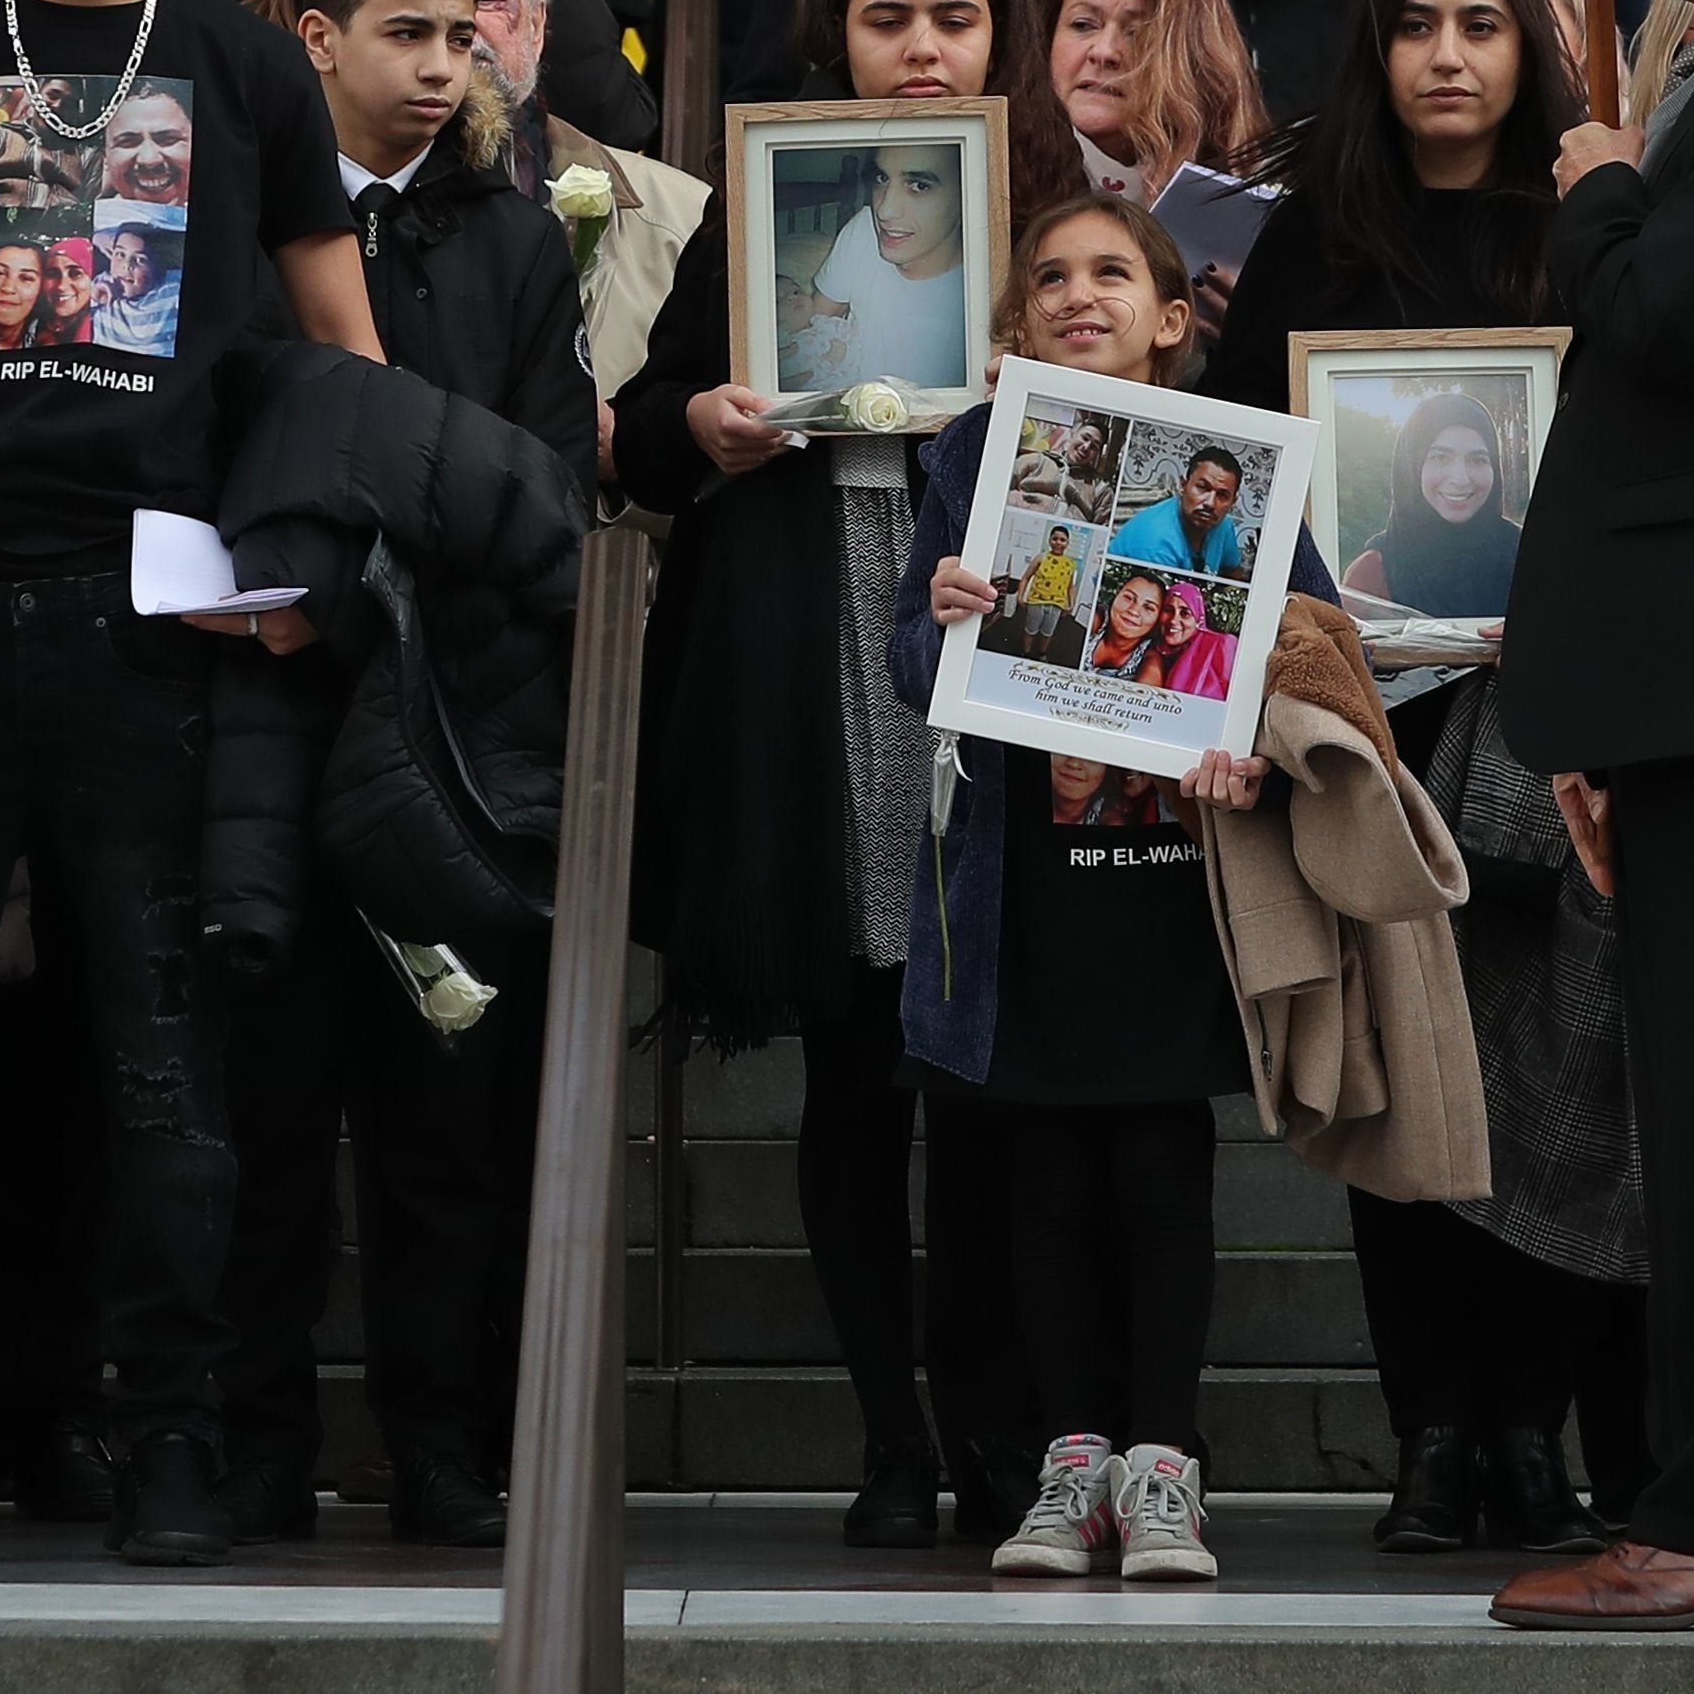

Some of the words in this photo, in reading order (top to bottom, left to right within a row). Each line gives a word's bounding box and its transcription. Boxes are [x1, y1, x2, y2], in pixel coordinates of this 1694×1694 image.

[0, 361, 35, 381] RIP
[39, 360, 155, 393] EL-WAHABI
[1008, 668, 1041, 686] From
[1044, 676, 1073, 692] God
[1073, 684, 1091, 696] we
[1093, 690, 1124, 703] came
[1126, 696, 1154, 709] and
[1154, 701, 1183, 715] unto
[1035, 688, 1058, 704] him
[1061, 697, 1080, 708] we
[1081, 700, 1113, 717] shall
[1114, 707, 1154, 724] return
[1070, 848, 1106, 866] RIP
